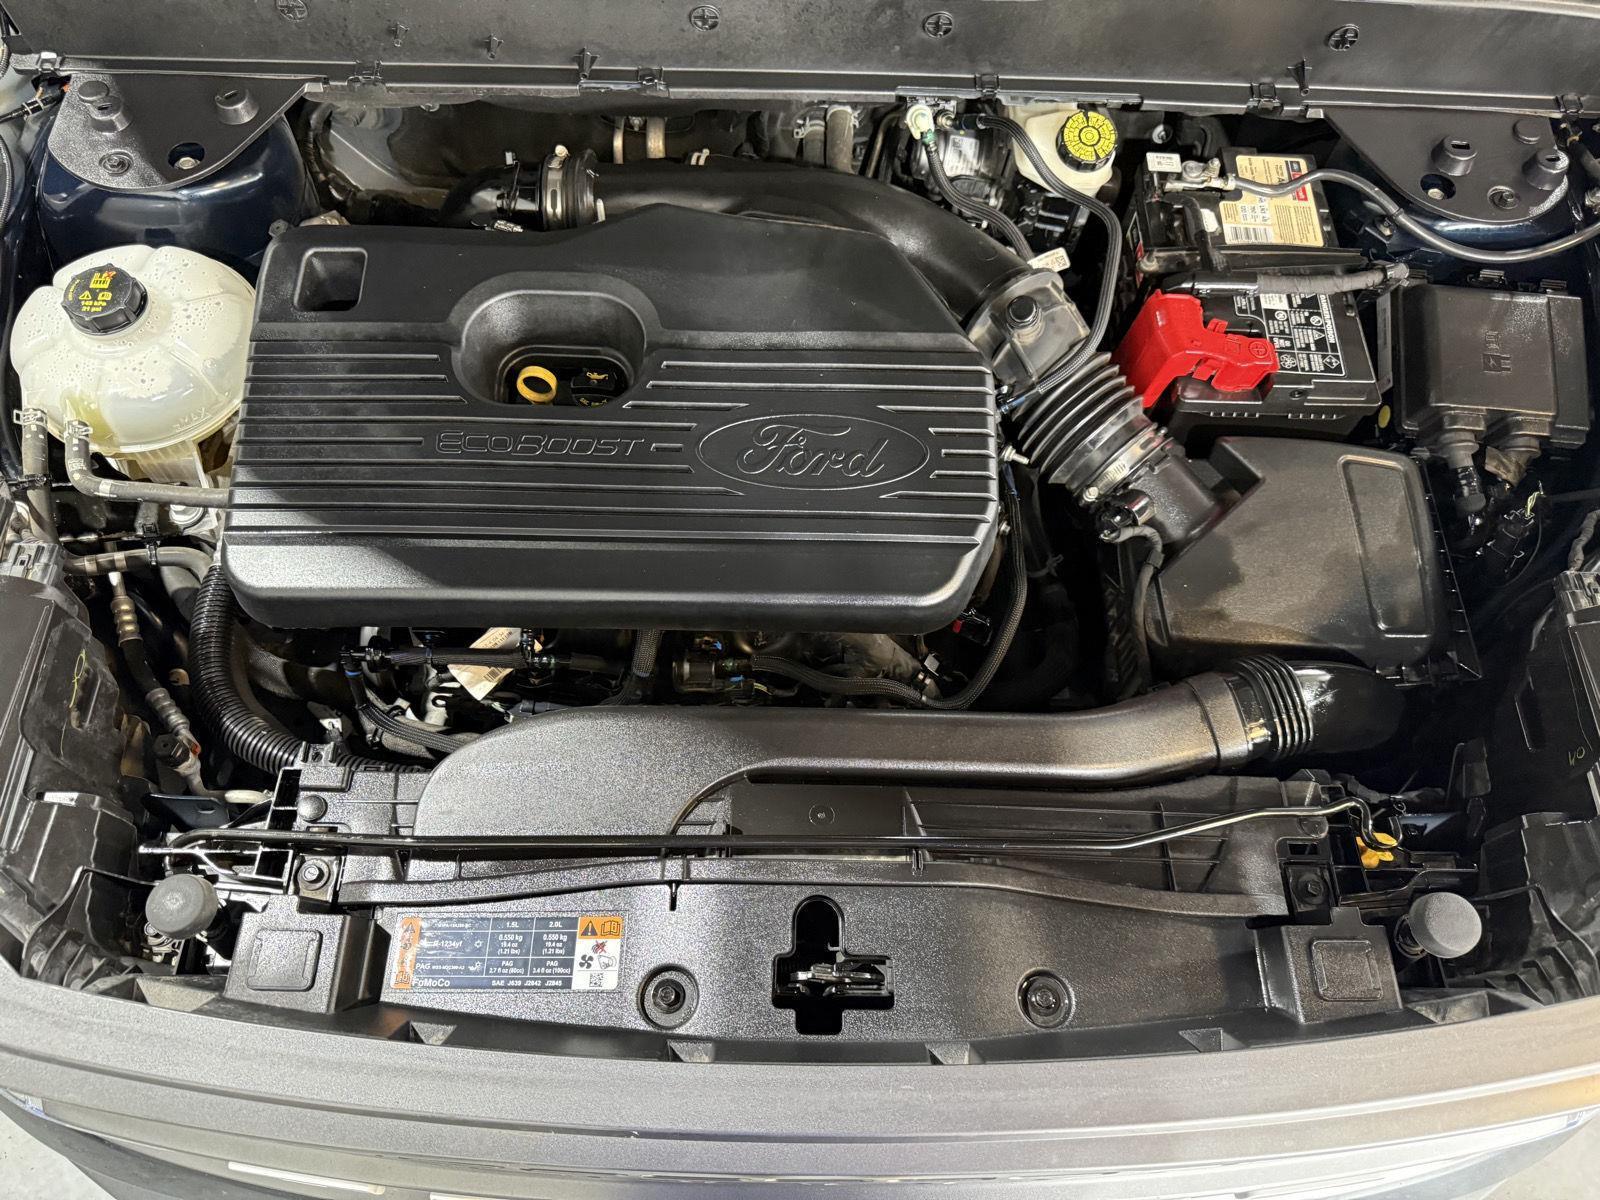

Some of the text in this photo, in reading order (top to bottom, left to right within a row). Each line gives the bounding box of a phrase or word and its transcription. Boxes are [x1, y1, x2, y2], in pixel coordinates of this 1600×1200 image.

[736, 423, 890, 479] Ford
[515, 934, 523, 942] kg
[560, 934, 568, 942] kg
[412, 977, 451, 987] FoMoCo
